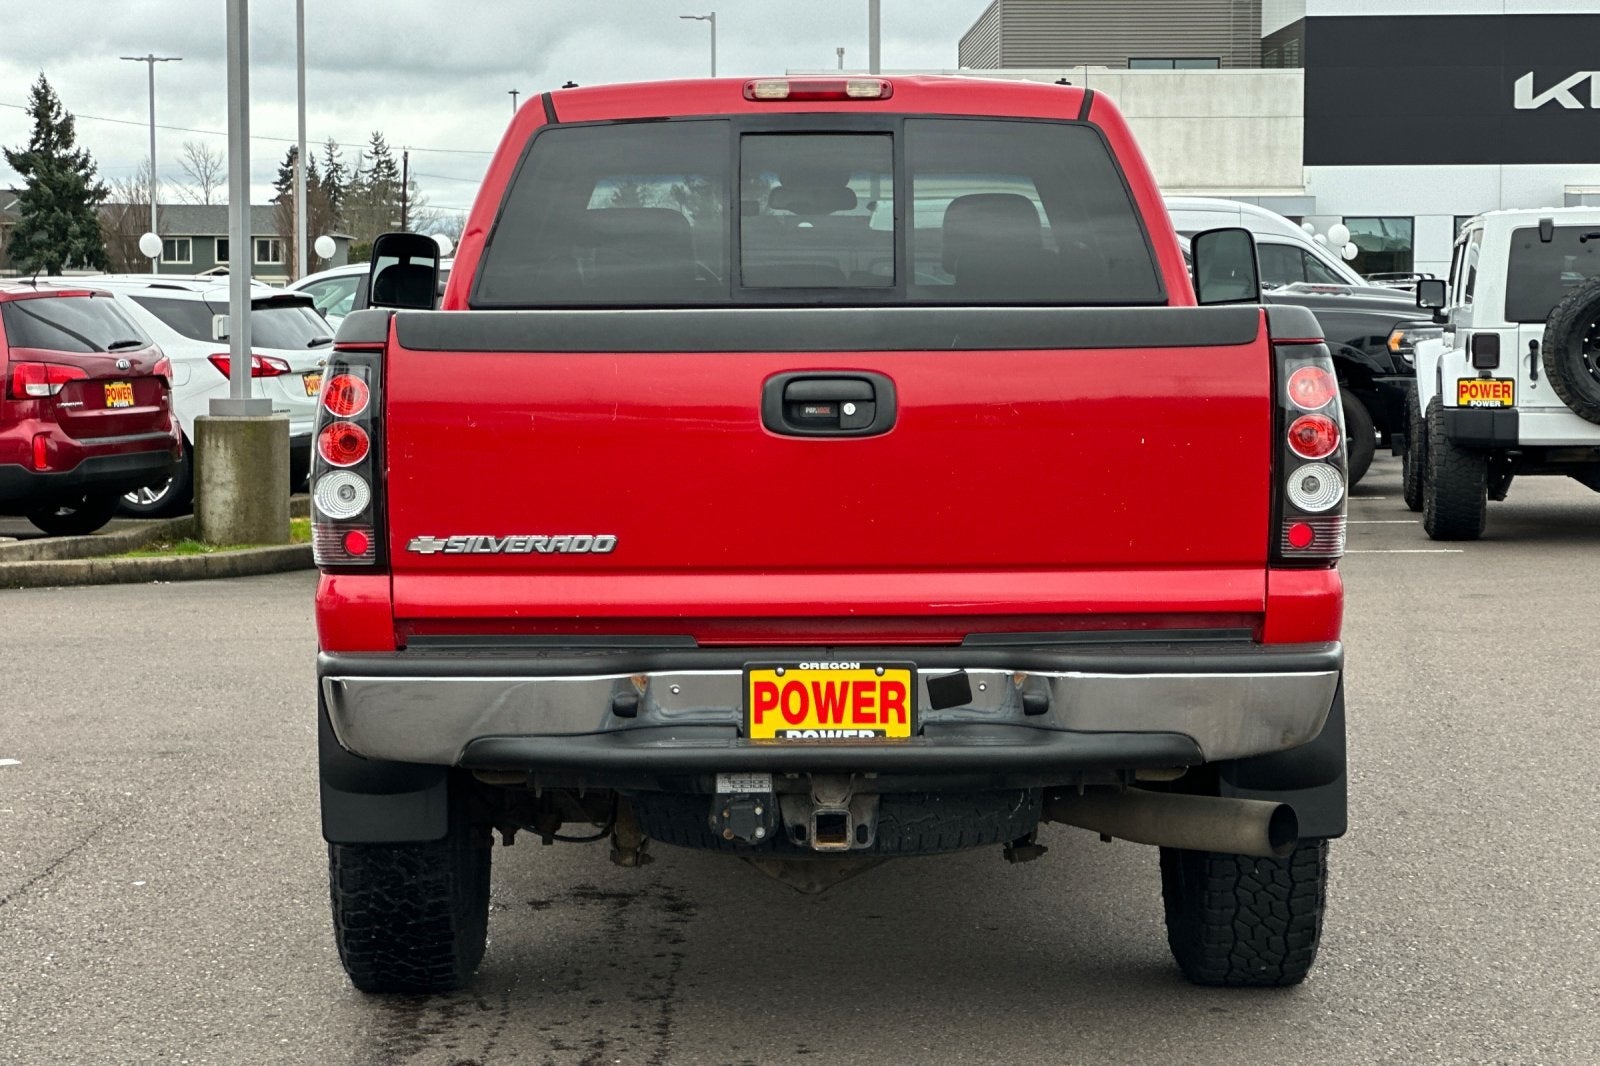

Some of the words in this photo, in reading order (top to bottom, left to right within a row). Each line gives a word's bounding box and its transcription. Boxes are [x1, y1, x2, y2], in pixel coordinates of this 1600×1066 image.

[106, 387, 132, 400] POWER
[1460, 384, 1511, 398] POWER
[444, 535, 618, 554] SILVERADO
[799, 662, 861, 670] OREGON
[753, 680, 907, 725] POWER
